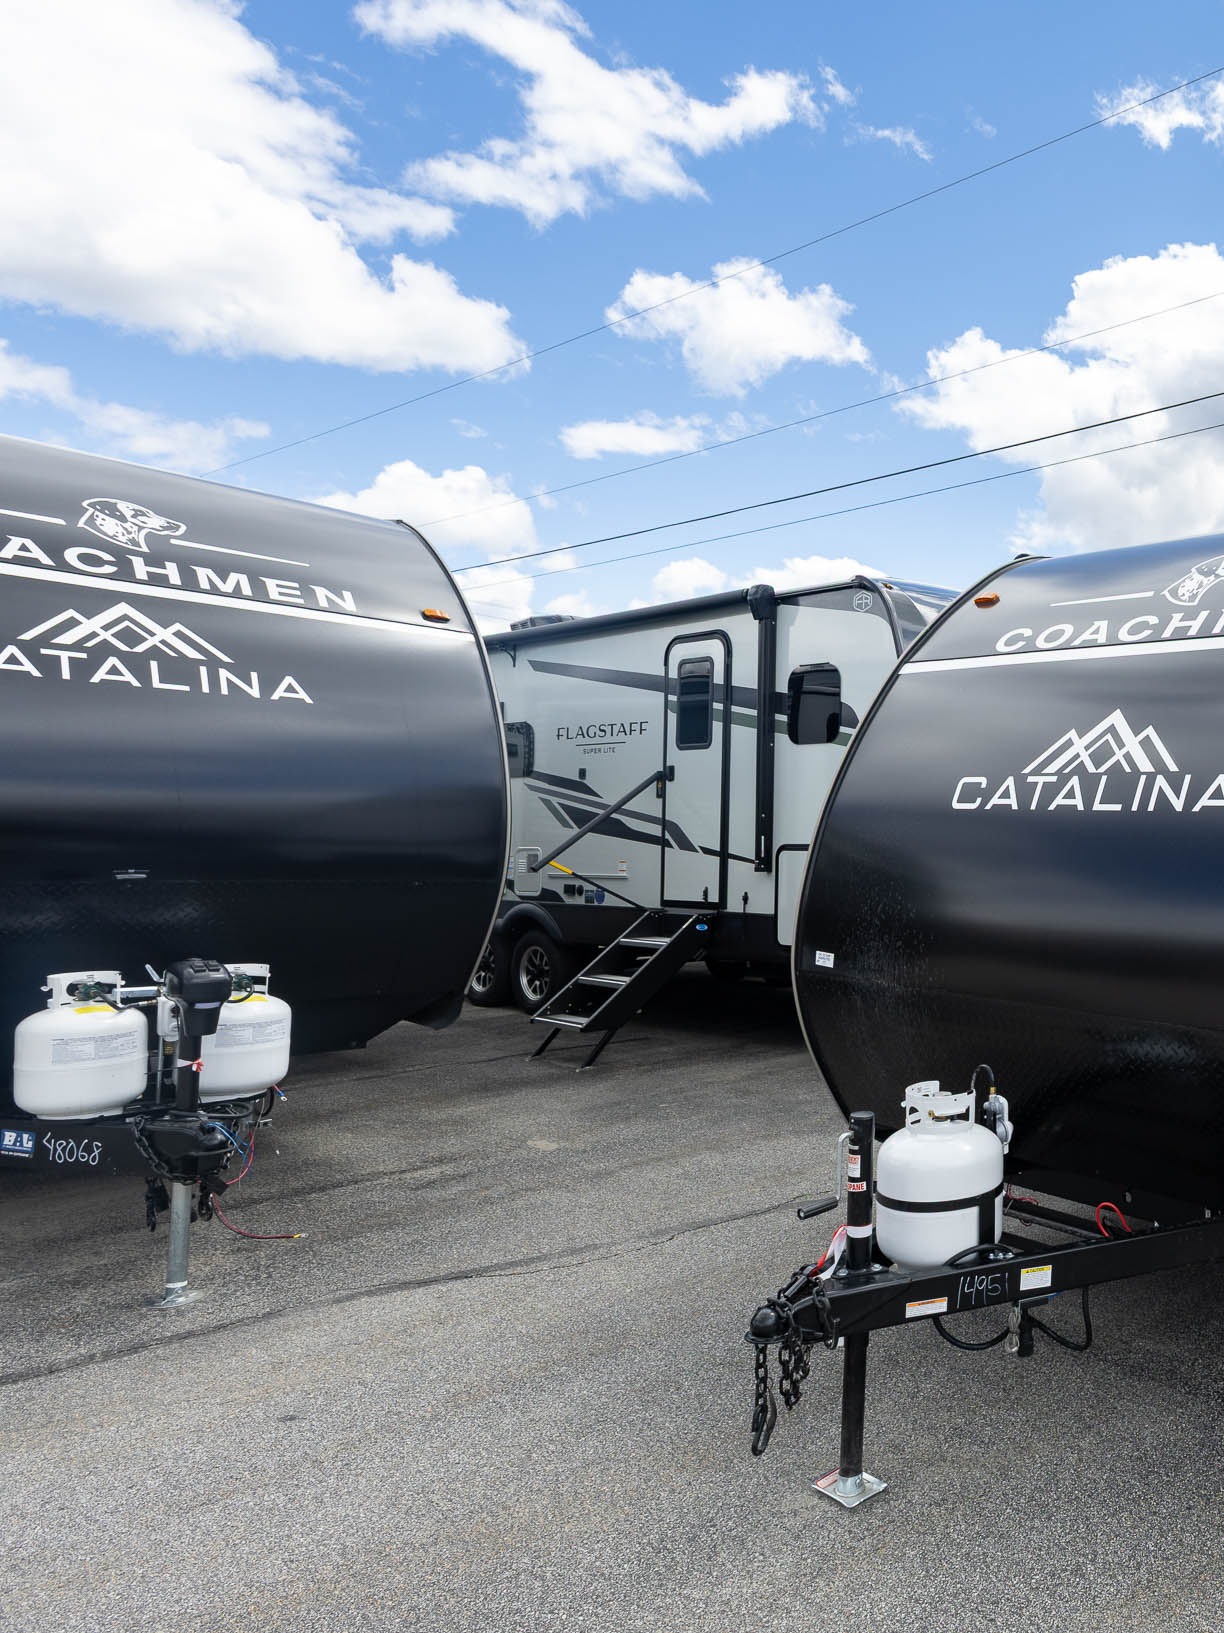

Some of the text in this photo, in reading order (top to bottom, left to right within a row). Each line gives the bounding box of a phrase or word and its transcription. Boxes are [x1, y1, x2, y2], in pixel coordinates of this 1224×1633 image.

[0, 644, 314, 704] ATALINA
[556, 721, 648, 740] FLAGSTAFF
[583, 747, 602, 755] SUPER
[43, 1131, 103, 1165] 48068
[956, 1272, 1009, 1309] 14951
